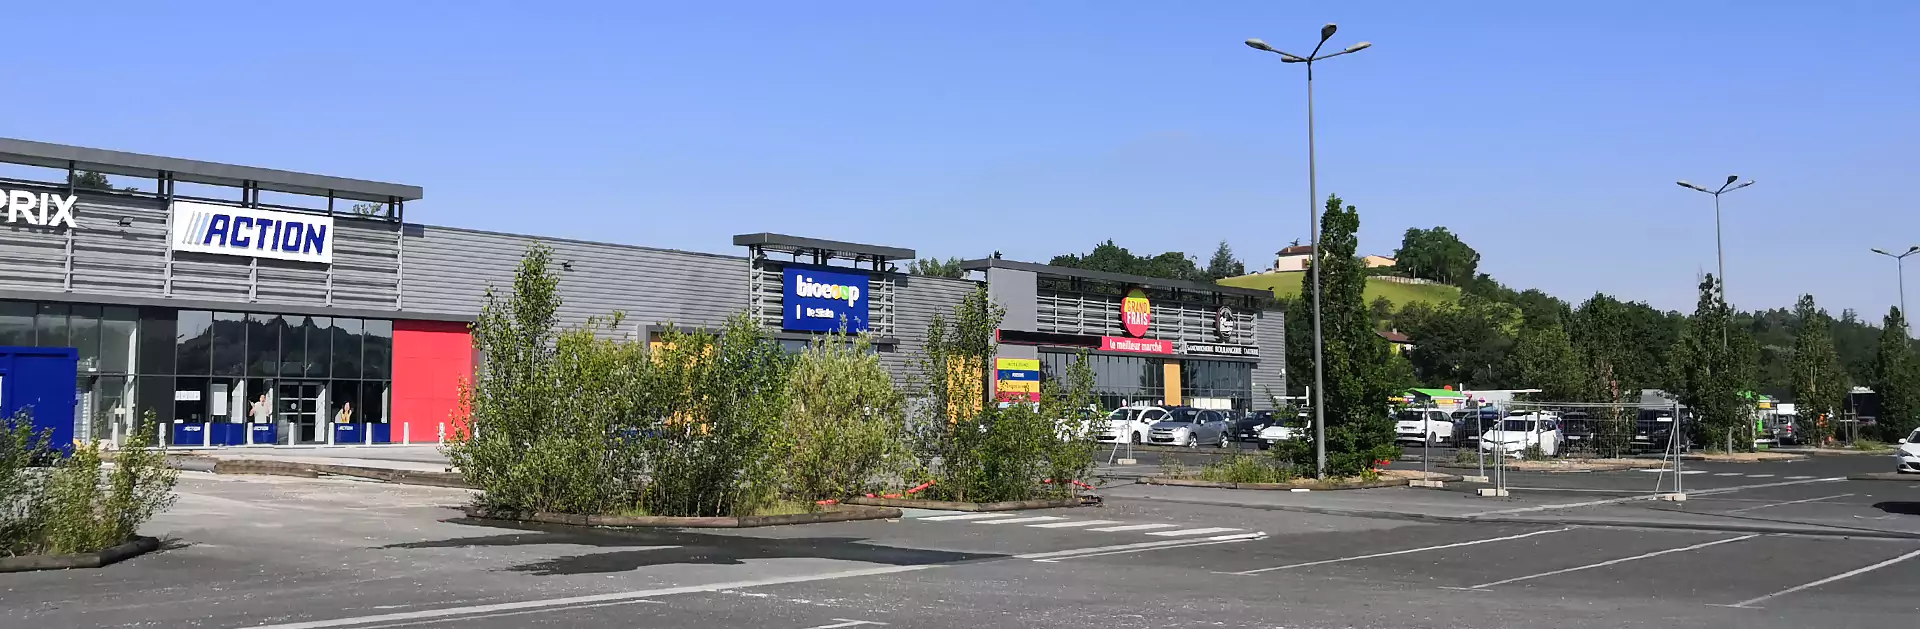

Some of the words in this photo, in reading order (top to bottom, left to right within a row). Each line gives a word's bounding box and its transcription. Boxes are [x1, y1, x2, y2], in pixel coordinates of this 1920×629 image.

[0, 189, 78, 228] RIX
[204, 214, 326, 255] ACTION
[1127, 300, 1148, 313] GRAND
[1127, 312, 1149, 326] FRAIS
[1117, 340, 1140, 351] meilleur
[1141, 341, 1162, 352] marché
